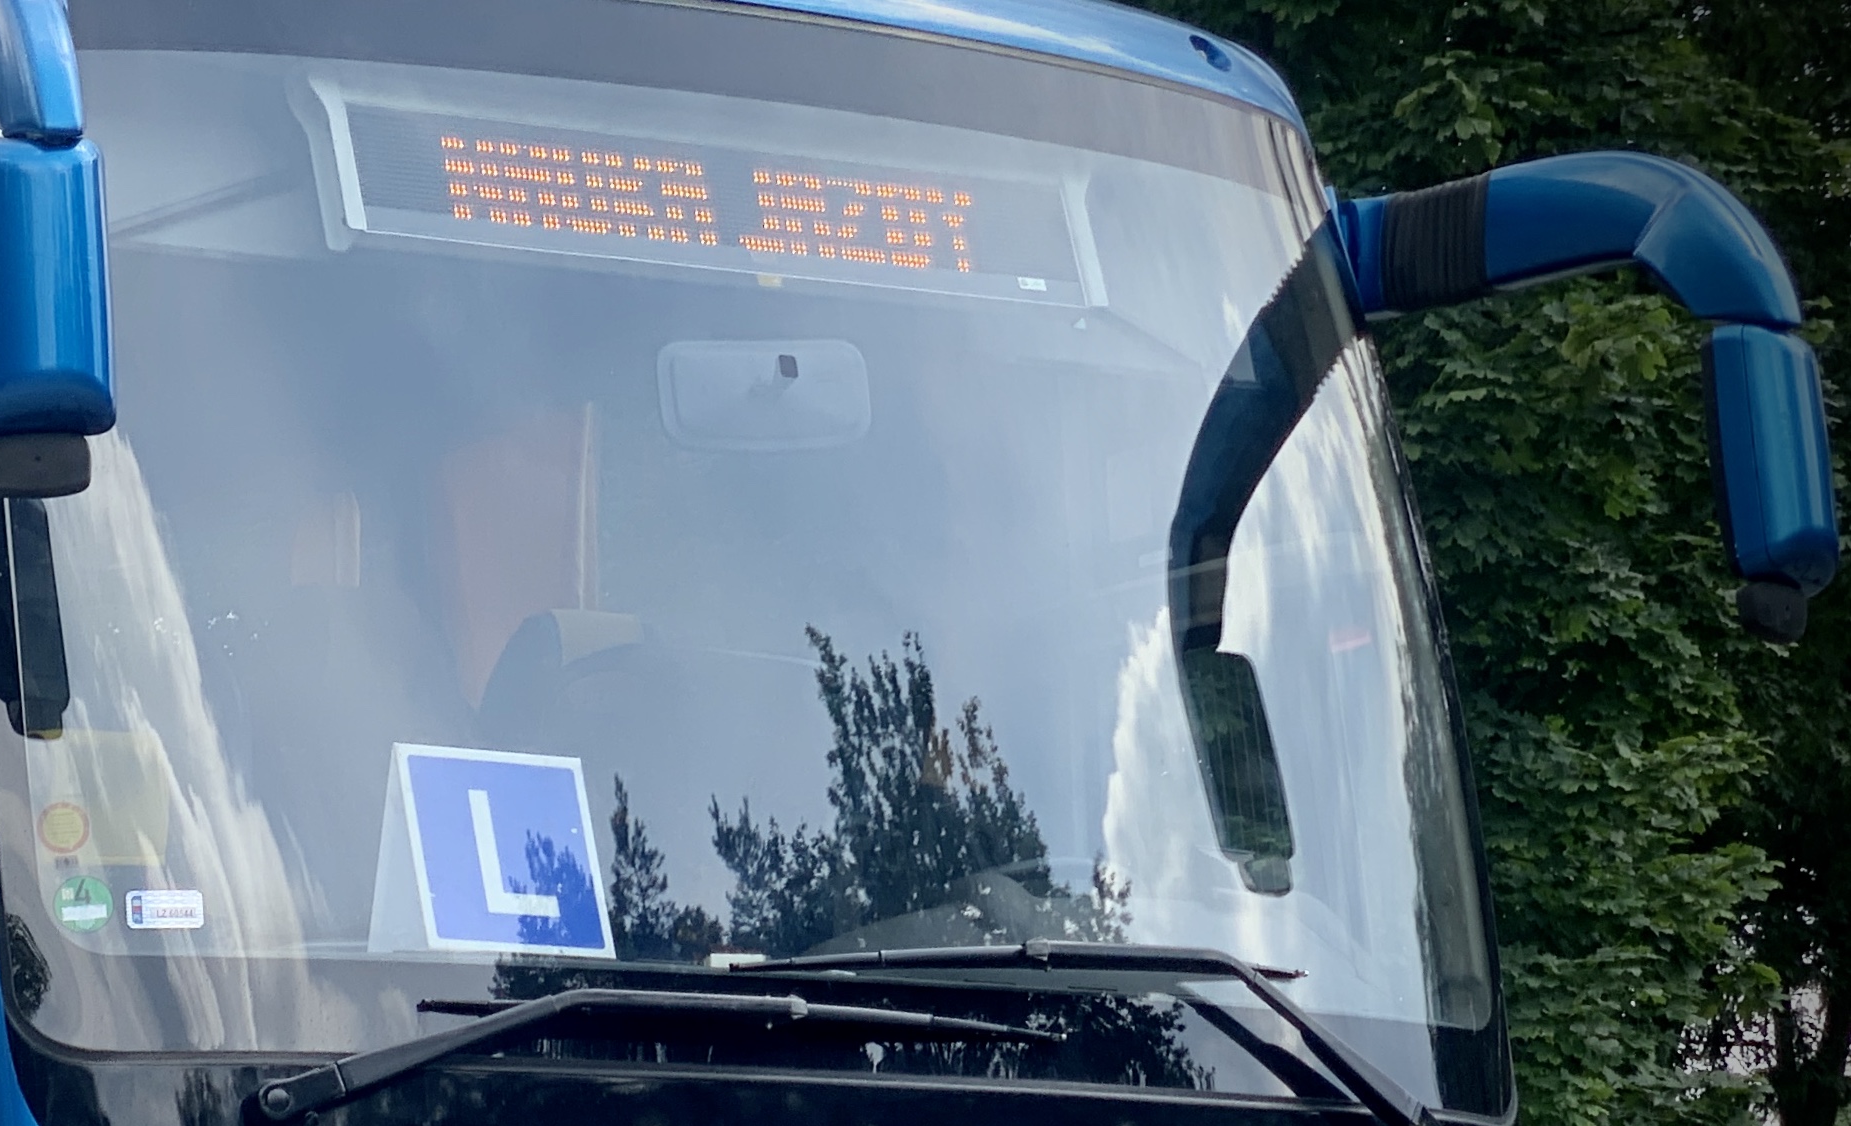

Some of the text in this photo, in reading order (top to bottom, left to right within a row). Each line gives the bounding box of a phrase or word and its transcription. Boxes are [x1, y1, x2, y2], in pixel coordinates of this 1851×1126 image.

[467, 789, 561, 918] L
[74, 878, 91, 905] 4
[156, 907, 195, 918] LZ 60544
